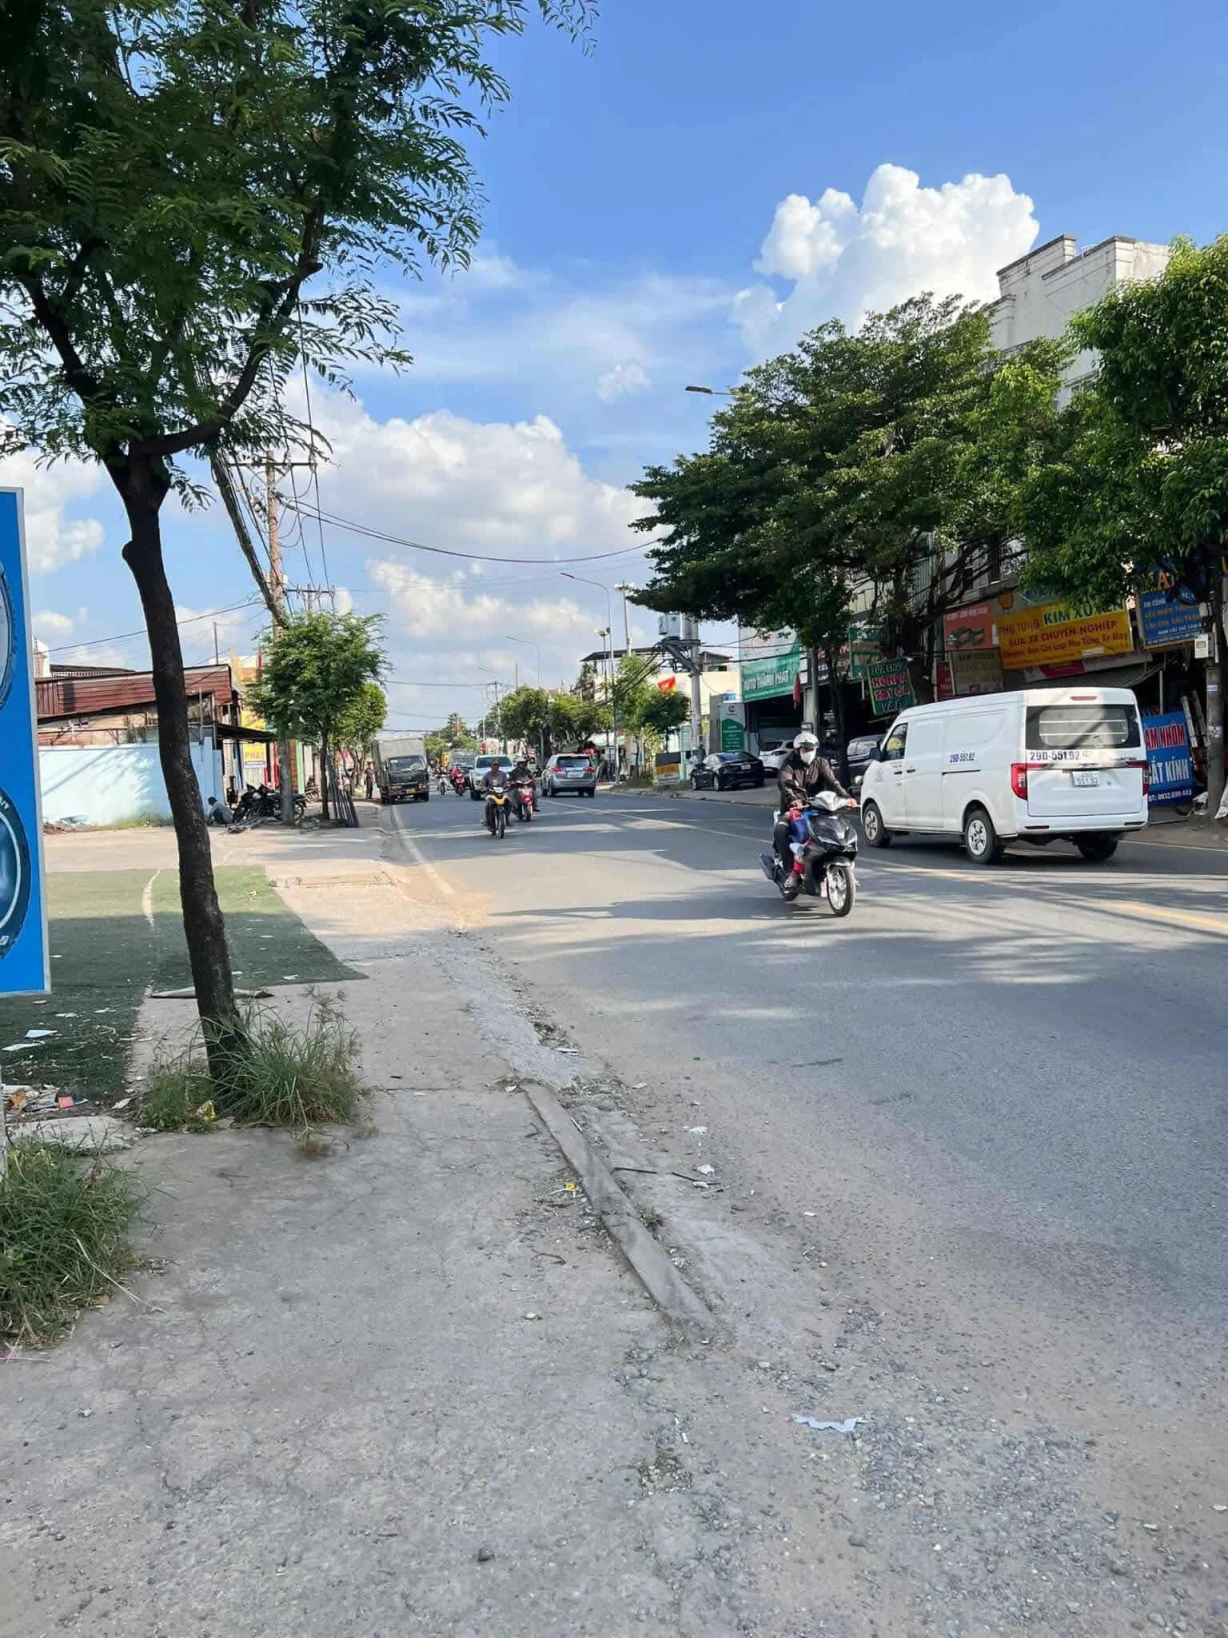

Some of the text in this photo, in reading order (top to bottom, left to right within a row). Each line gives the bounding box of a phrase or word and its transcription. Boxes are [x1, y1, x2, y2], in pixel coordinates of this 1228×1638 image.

[1044, 610, 1070, 625] KIM
[1030, 751, 1080, 761] 29D-551.92
[1165, 755, 1190, 782] KÍNH
